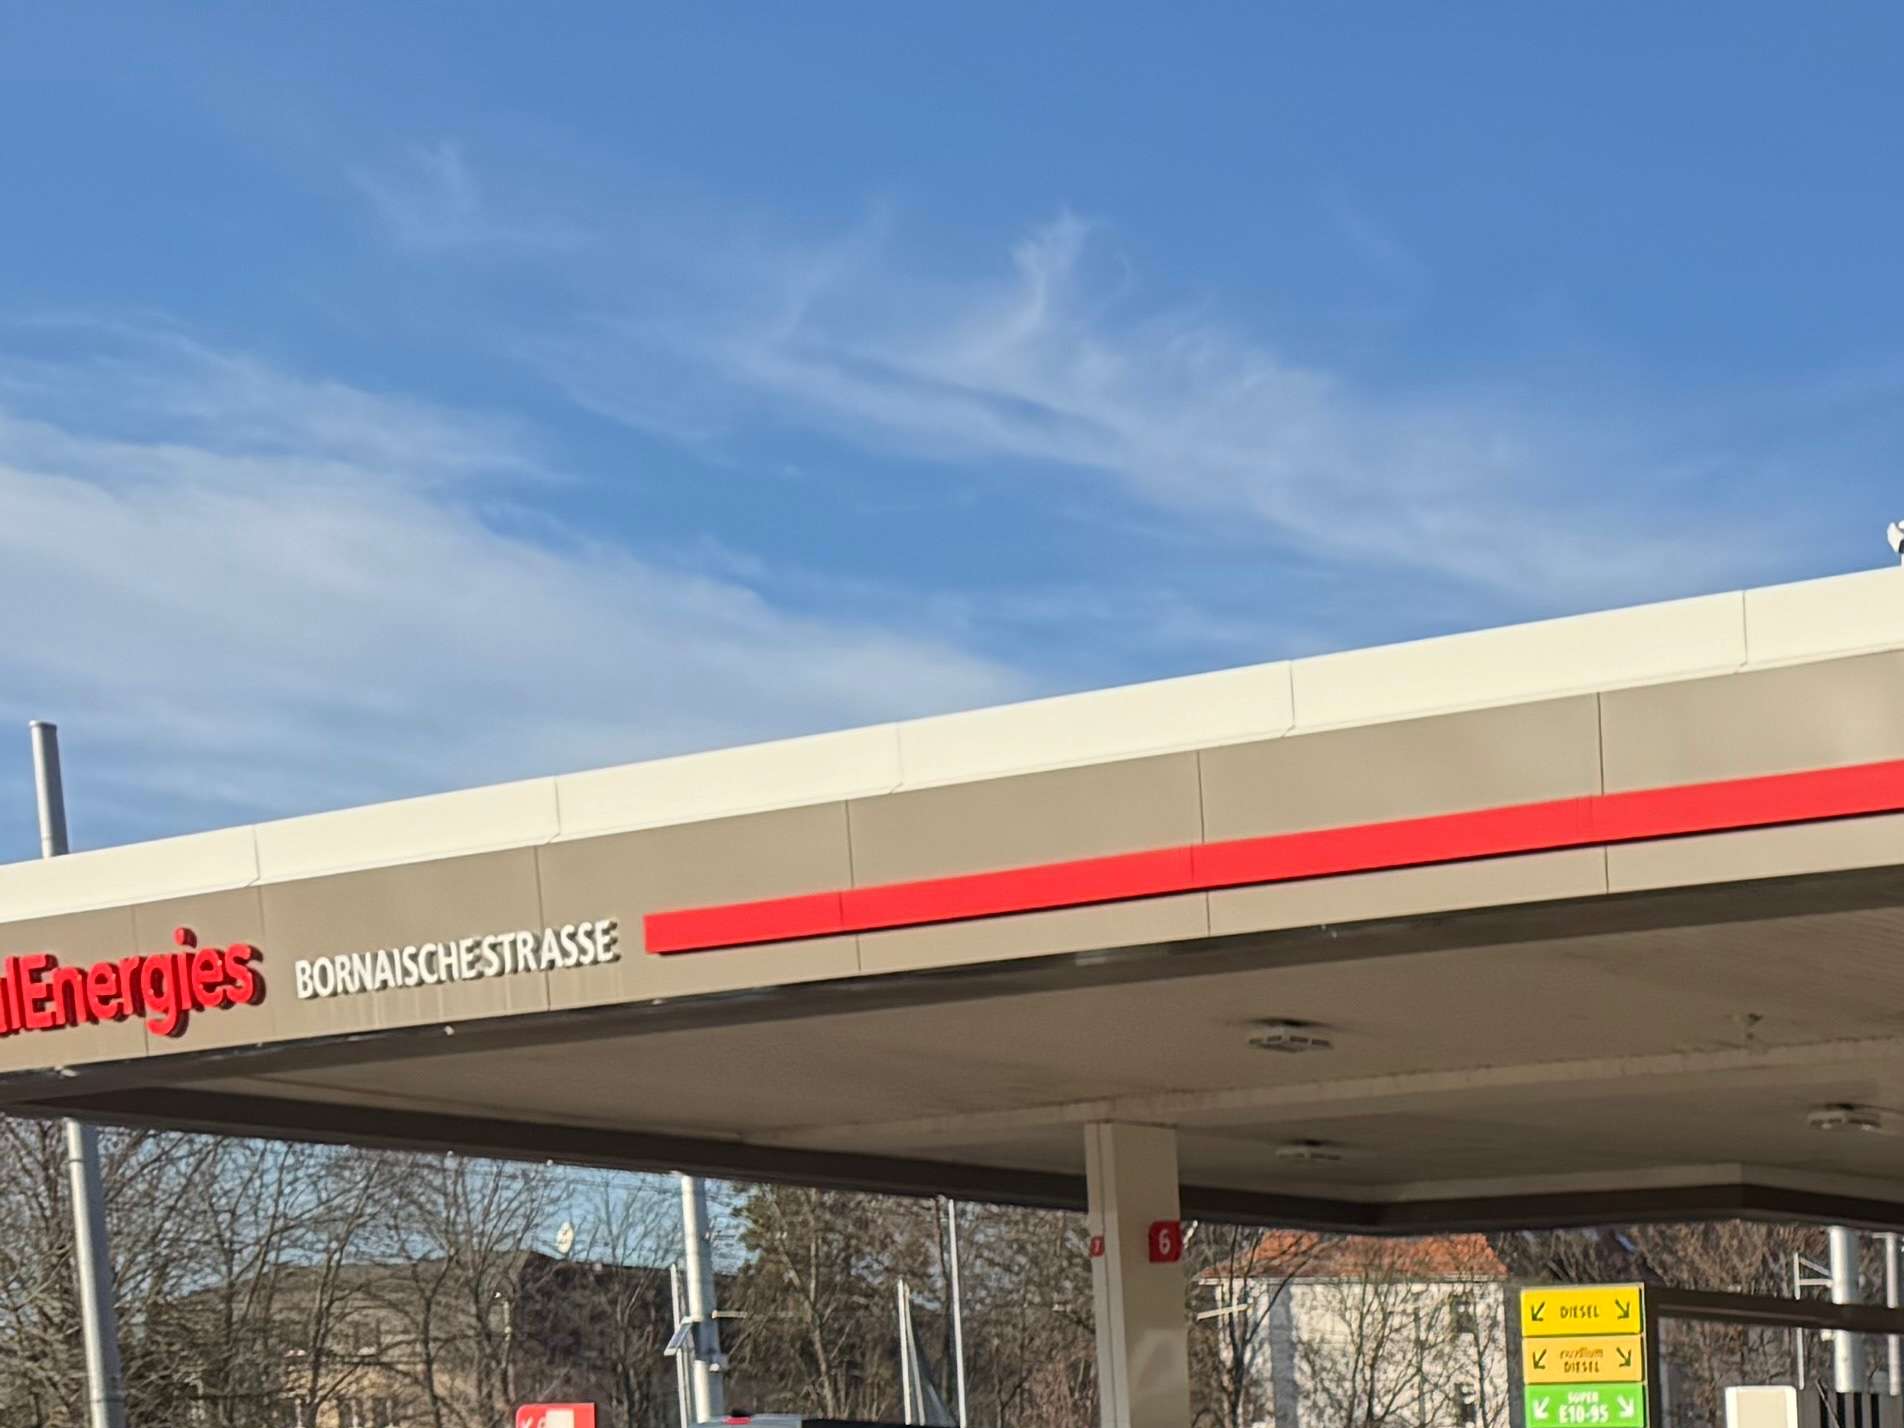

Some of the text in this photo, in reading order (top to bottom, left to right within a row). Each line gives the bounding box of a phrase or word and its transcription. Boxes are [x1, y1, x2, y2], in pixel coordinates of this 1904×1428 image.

[0, 927, 258, 1036] lEnergies
[1158, 1228, 1170, 1255] 6
[1560, 1305, 1600, 1319] DIESEL
[1564, 1361, 1600, 1373] DIESEL
[1559, 1403, 1609, 1424] E10-95
